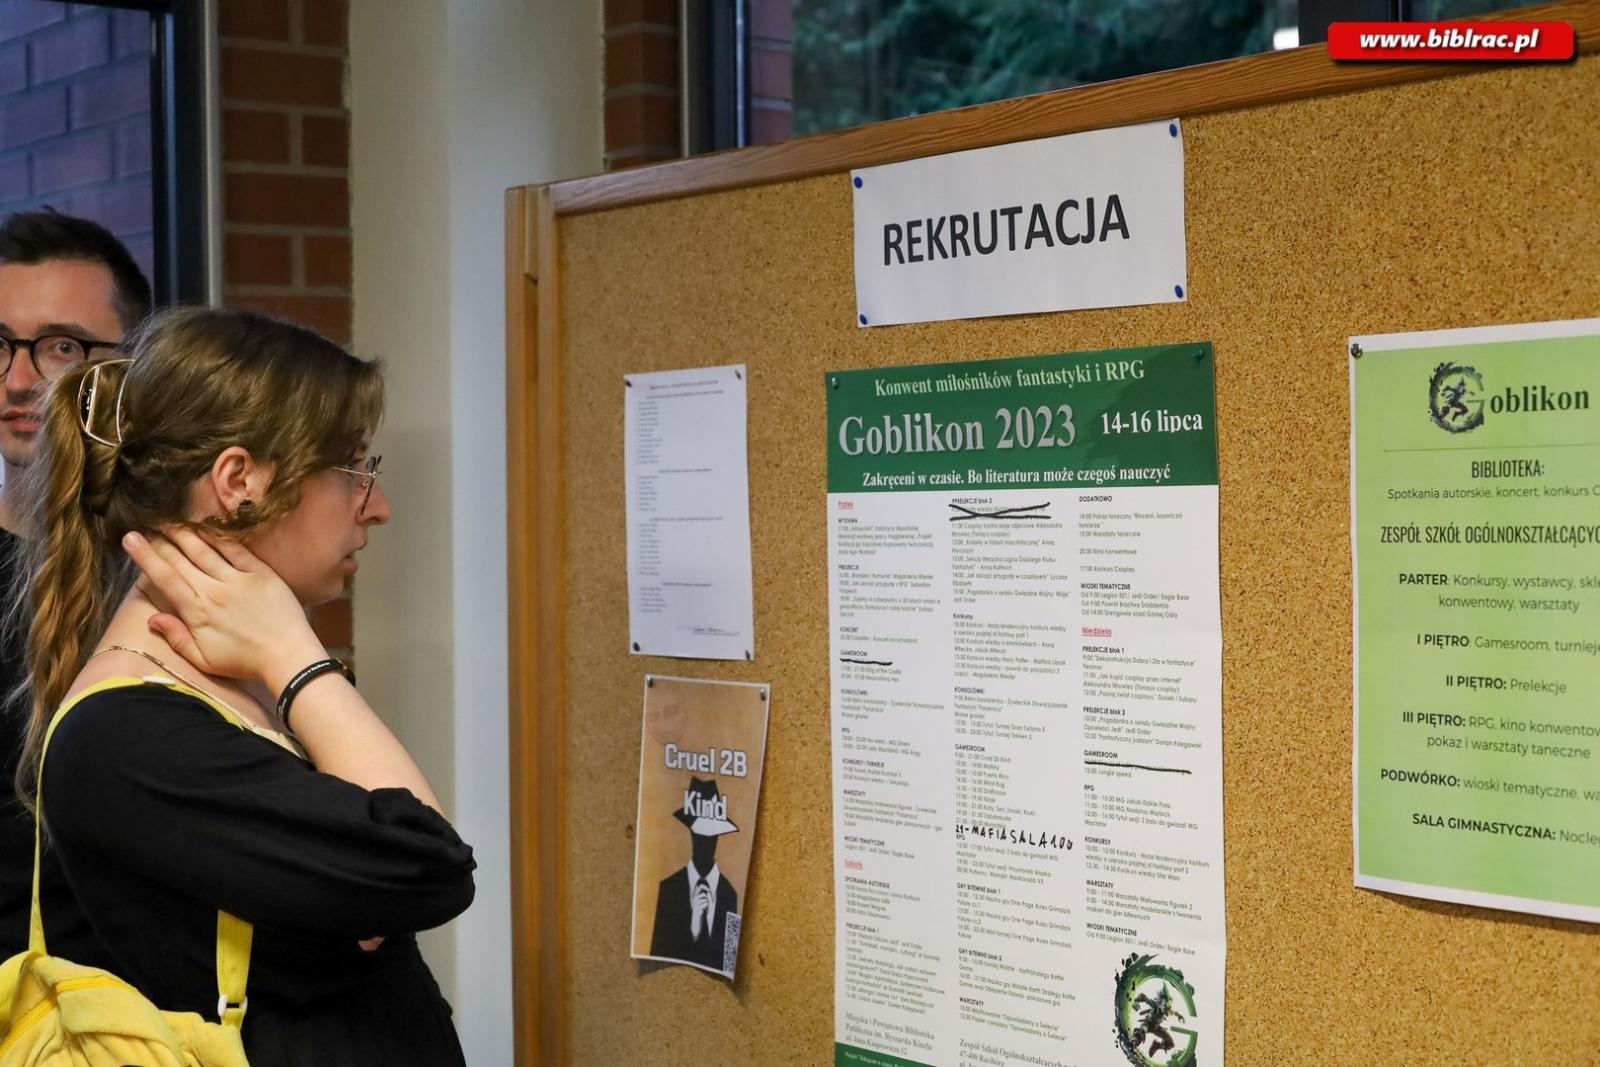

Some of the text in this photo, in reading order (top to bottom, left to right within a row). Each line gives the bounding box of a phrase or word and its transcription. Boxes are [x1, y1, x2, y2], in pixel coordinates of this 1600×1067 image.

[883, 194, 1130, 265] REKRUTACJA
[875, 359, 1145, 396] Konwent miłośników fantastyki i RPG
[839, 404, 1076, 456] Goblikon 2023
[1101, 409, 1203, 434] 14-16 lipca
[862, 463, 1171, 488] Zakręceni w czasie. Bo literatura może czegoś nauczyć
[1471, 460, 1545, 478] BIBLIOTEKA:
[1387, 488, 1440, 501] Spotkania
[1544, 485, 1590, 497] konkurs
[1380, 522, 1421, 544] ZESPÓŁ
[1425, 522, 1461, 543] SZKÓŁ
[1520, 598, 1580, 613] warsztaty
[1417, 634, 1420, 645] I
[1446, 675, 1567, 694] II PIĘTRO: Prelekcje
[1403, 711, 1414, 722] III
[1417, 712, 1466, 728] PIĘTRO:
[1500, 719, 1526, 732] kino
[1427, 736, 1591, 759] pokaz i warsztaty taneczne
[664, 742, 748, 777] Cruel 2B
[1381, 768, 1460, 787] PODWÓRKO:
[1463, 777, 1499, 791] wioski
[683, 789, 728, 821] Kind
[1412, 813, 1600, 847] SALA GIMNASTYCZNA: Nocle
